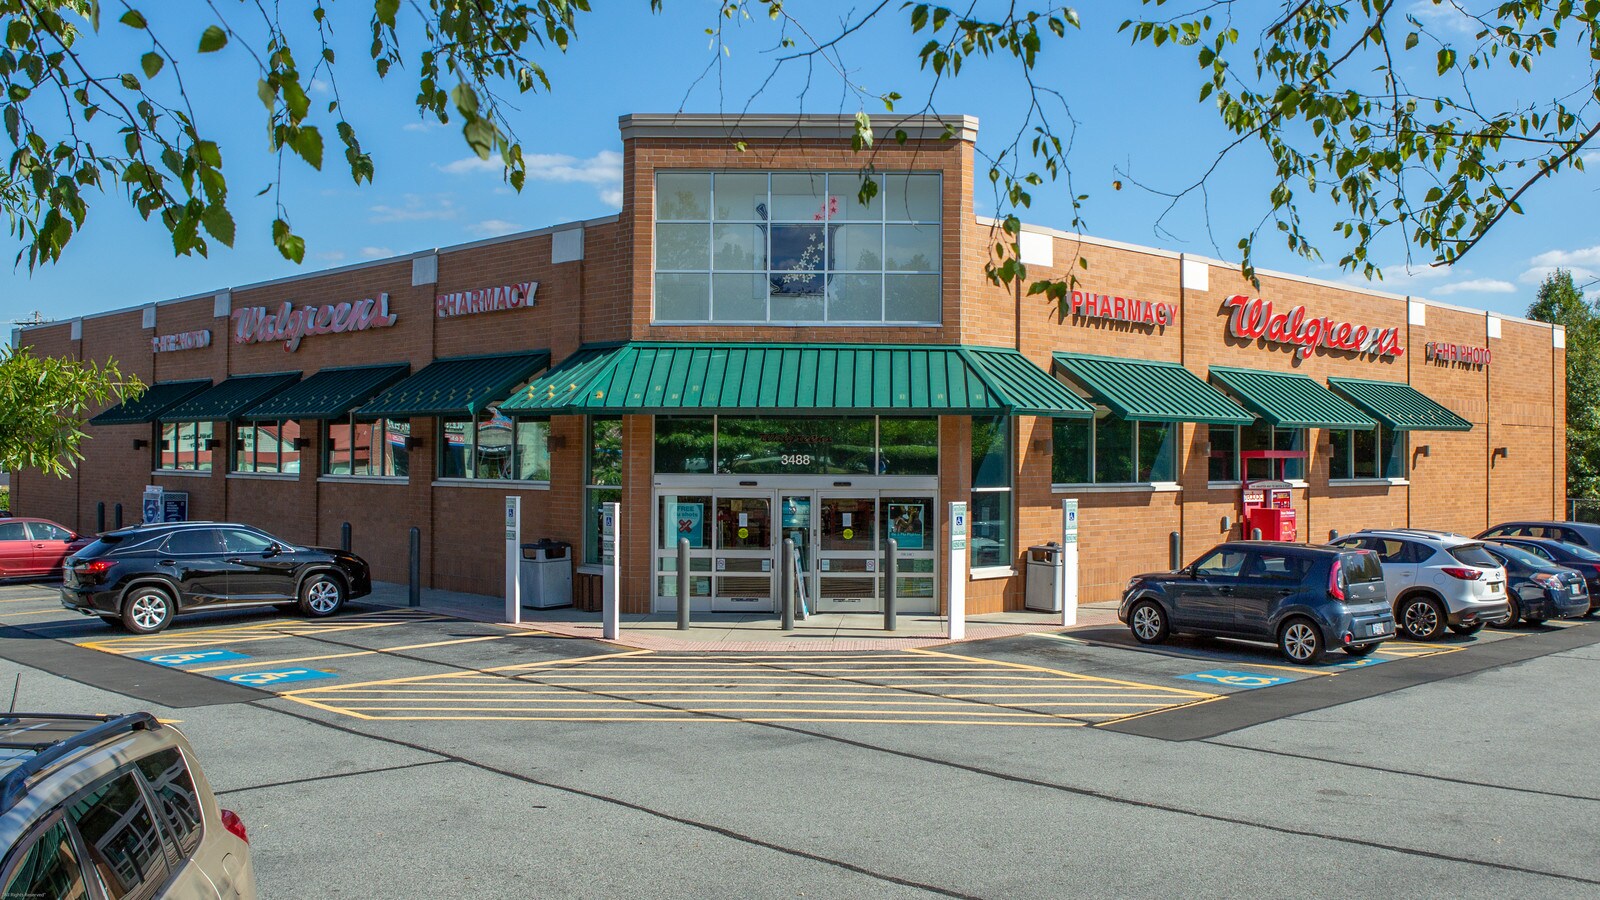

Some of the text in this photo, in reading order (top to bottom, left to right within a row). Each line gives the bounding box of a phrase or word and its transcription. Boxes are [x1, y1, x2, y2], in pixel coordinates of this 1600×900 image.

[437, 282, 538, 317] PHARMACY
[1070, 290, 1179, 326] PHARMACY
[231, 293, 397, 352] Walgreens
[1224, 294, 1406, 359] Walgreens
[1461, 345, 1492, 364] PHOTO
[781, 454, 810, 465] 3488
